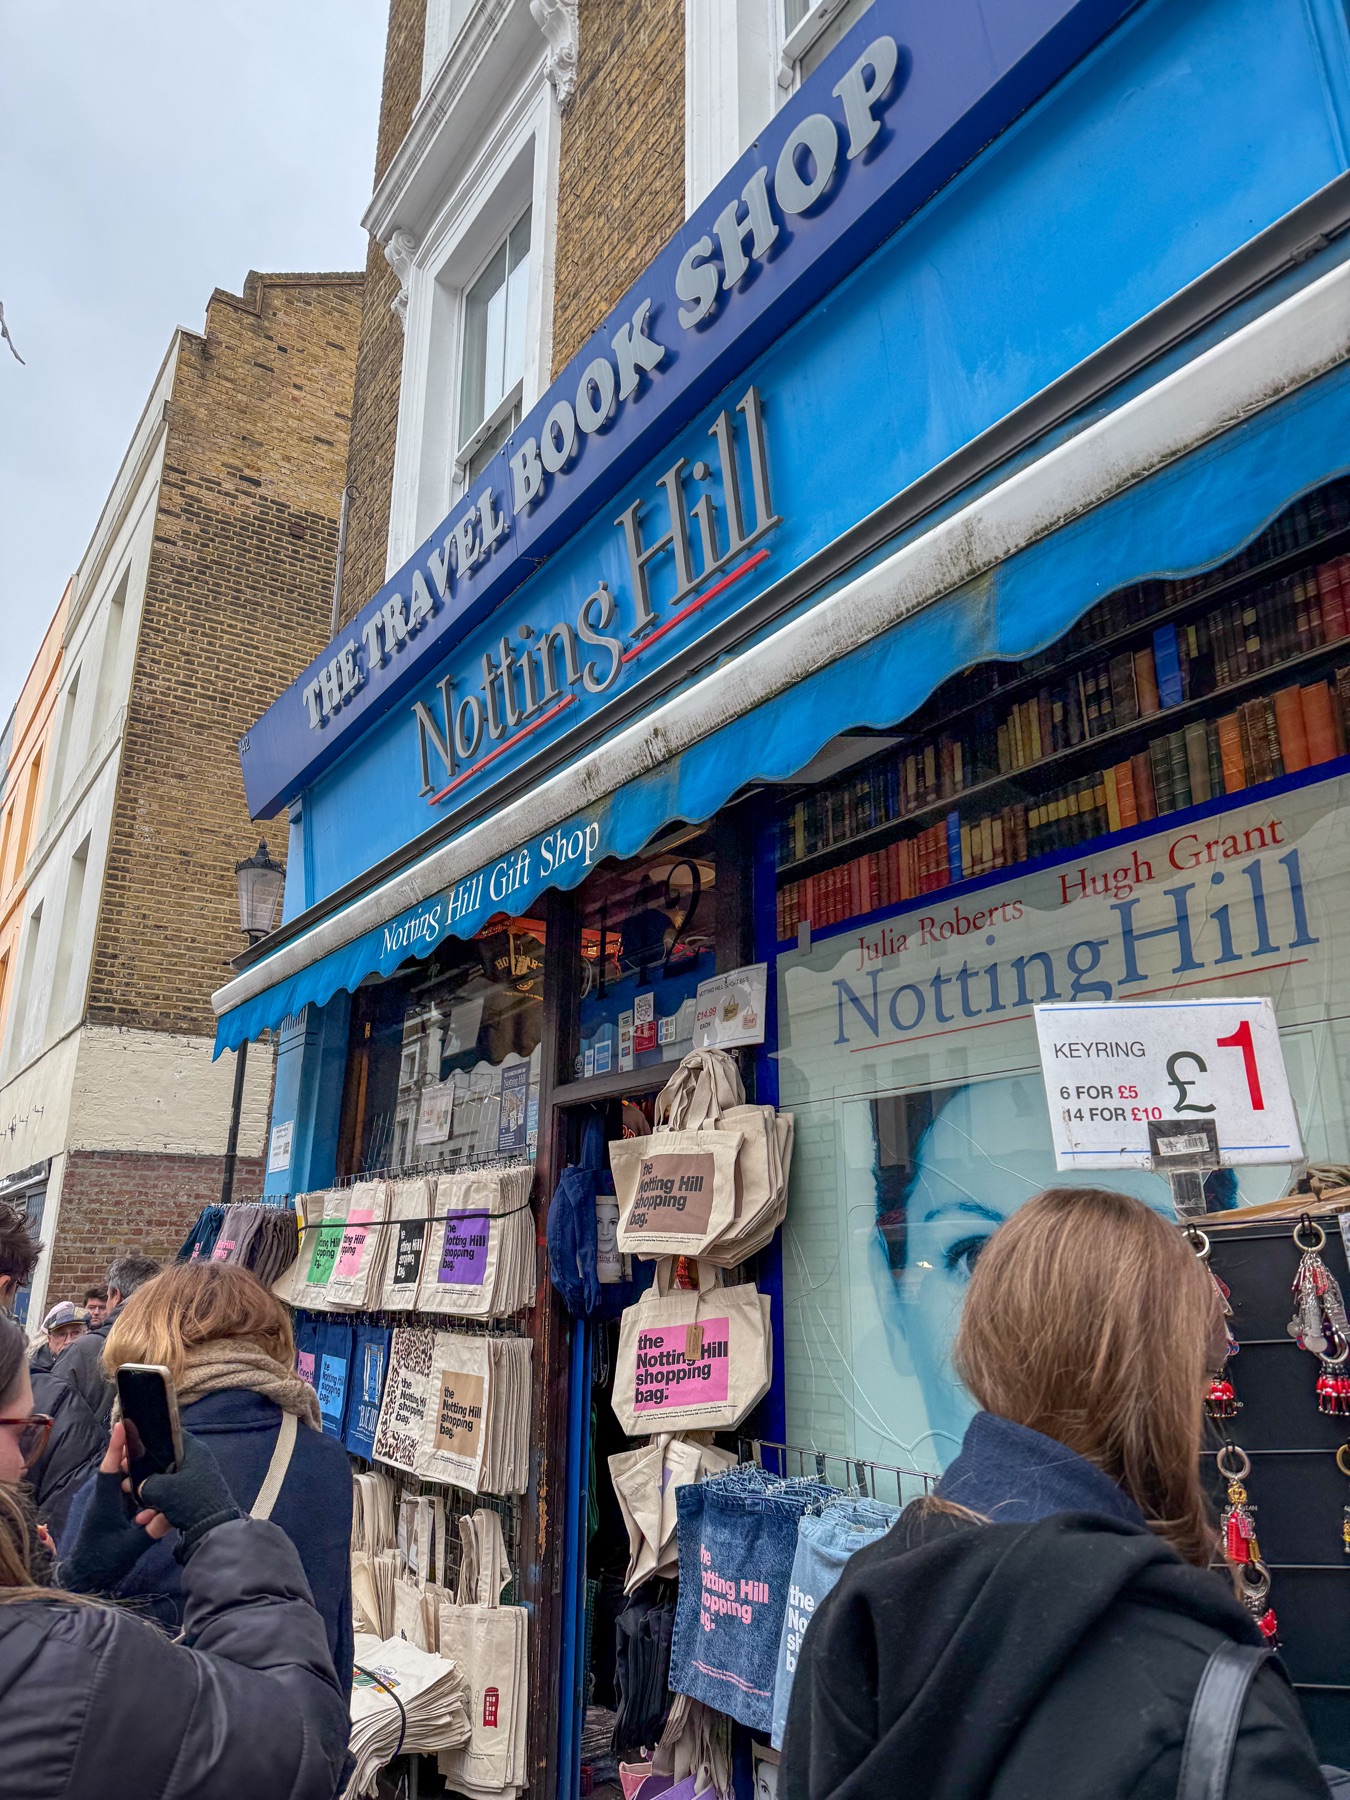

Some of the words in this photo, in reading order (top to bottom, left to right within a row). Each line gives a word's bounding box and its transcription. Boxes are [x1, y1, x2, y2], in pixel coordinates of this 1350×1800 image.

[303, 638, 360, 729] THE
[362, 487, 504, 669] TRAVEL
[510, 298, 665, 515] BOOK
[675, 36, 898, 329] SHOP
[410, 581, 625, 797] Notting
[614, 385, 783, 638] Hill
[380, 903, 442, 959] Notting
[445, 874, 483, 926] Hill
[489, 849, 531, 902] Gift
[539, 821, 599, 878] Shop
[857, 931, 908, 971] Julia
[918, 899, 1024, 947] Roberts
[1058, 849, 1156, 905] Hugh
[1168, 819, 1285, 871] Grant
[833, 935, 1113, 1046] Notting
[1110, 849, 1320, 987] Hill
[696, 1006, 716, 1021] £14.99
[659, 1025, 674, 1036] JCB
[1053, 1041, 1146, 1059] KEYRING
[1059, 1086, 1071, 1100] 6
[1076, 1085, 1114, 1100] FOR
[1118, 1085, 1138, 1099] £5
[1066, 1107, 1085, 1122] 14
[1089, 1107, 1127, 1121] FOR
[1131, 1107, 1163, 1121] £10
[678, 1176, 704, 1192] Hill
[634, 1194, 687, 1211] shopping
[469, 1235, 486, 1246] Hill
[638, 1334, 664, 1350] the
[701, 1341, 728, 1360] Hill
[401, 1378, 412, 1390] the
[635, 1363, 711, 1386] shopping
[444, 1386, 454, 1399] the
[398, 1401, 424, 1420] shopping
[442, 1399, 467, 1418] Notting
[468, 1405, 481, 1419] Hill
[441, 1412, 473, 1432] shopping
[701, 1544, 711, 1566] he
[701, 1568, 735, 1600] otting
[740, 1579, 769, 1604] Hill
[789, 1585, 814, 1612] the
